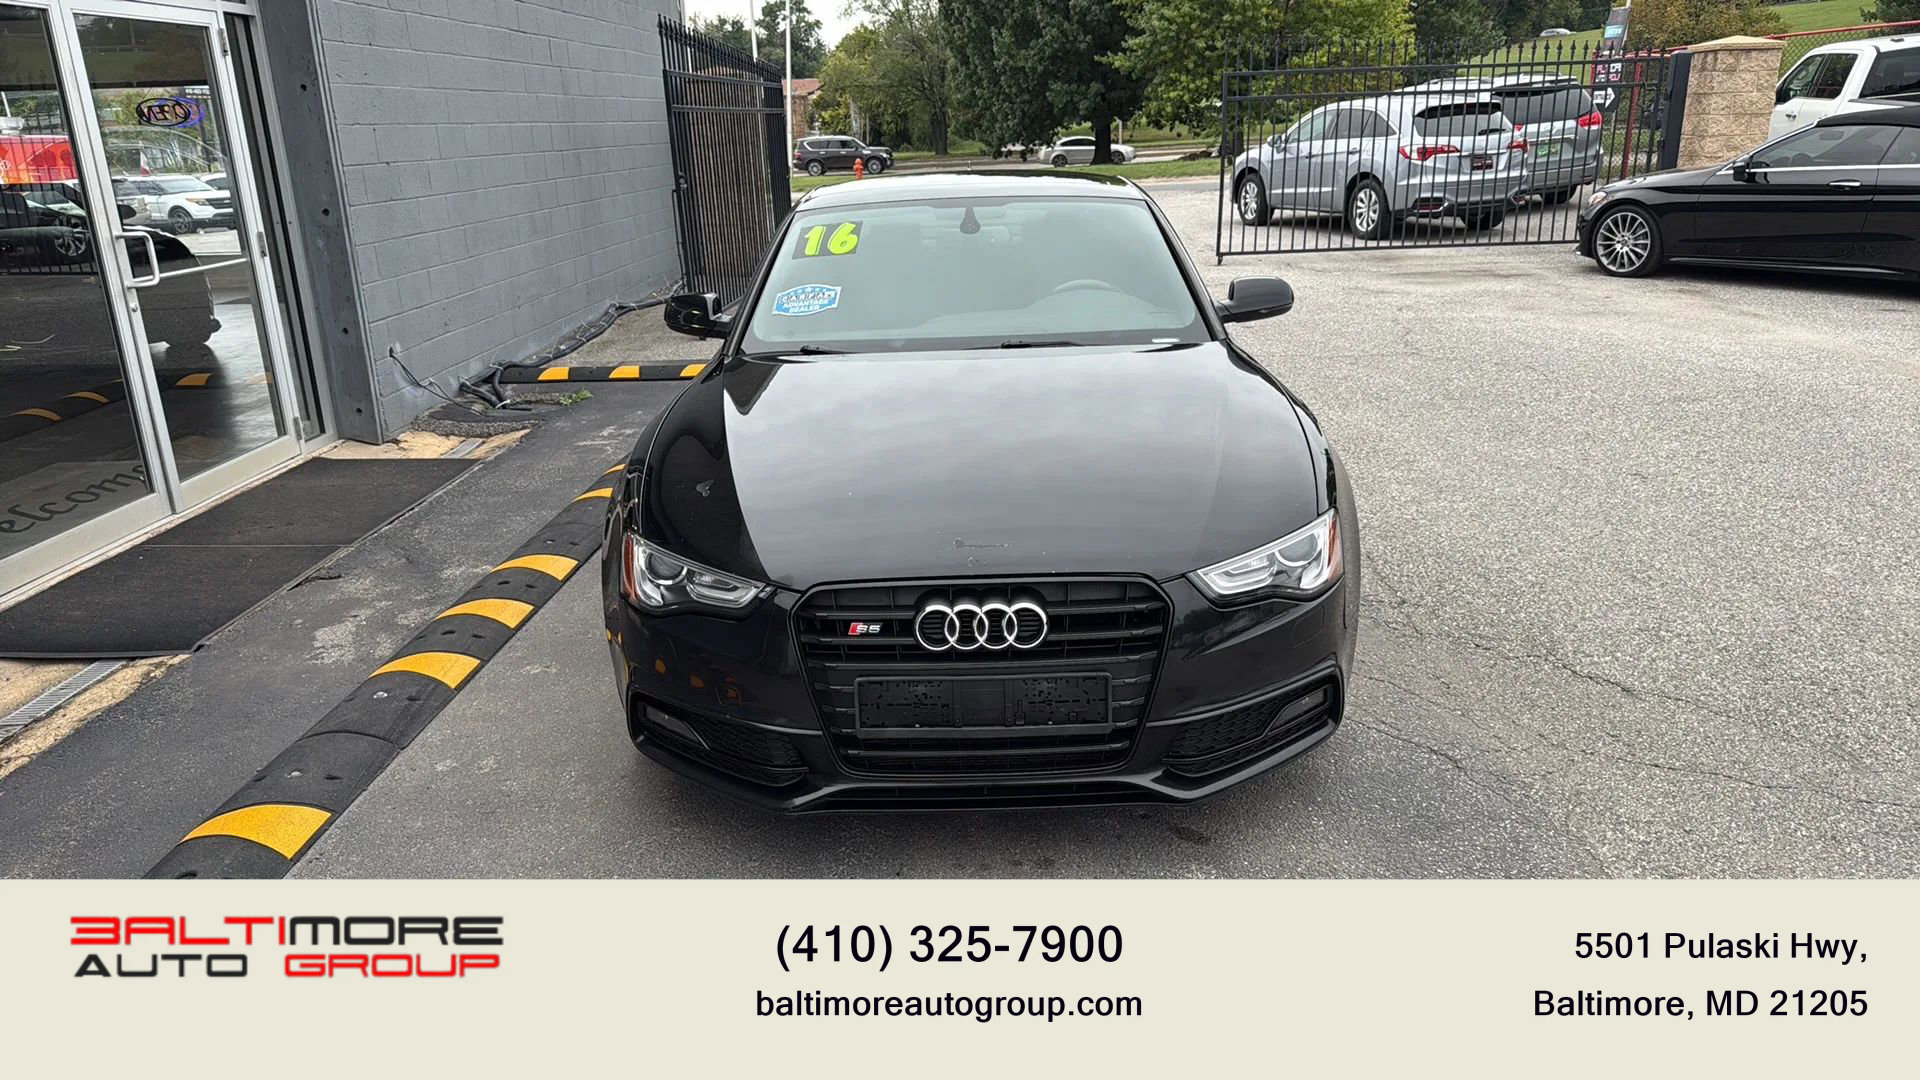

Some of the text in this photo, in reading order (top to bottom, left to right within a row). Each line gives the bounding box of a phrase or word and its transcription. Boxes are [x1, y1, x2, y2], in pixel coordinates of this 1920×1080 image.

[804, 222, 858, 256] 16
[782, 299, 829, 309] ADVANTAGE
[788, 305, 820, 313] DEALER
[0, 464, 149, 533] elcome
[855, 624, 881, 634] S5
